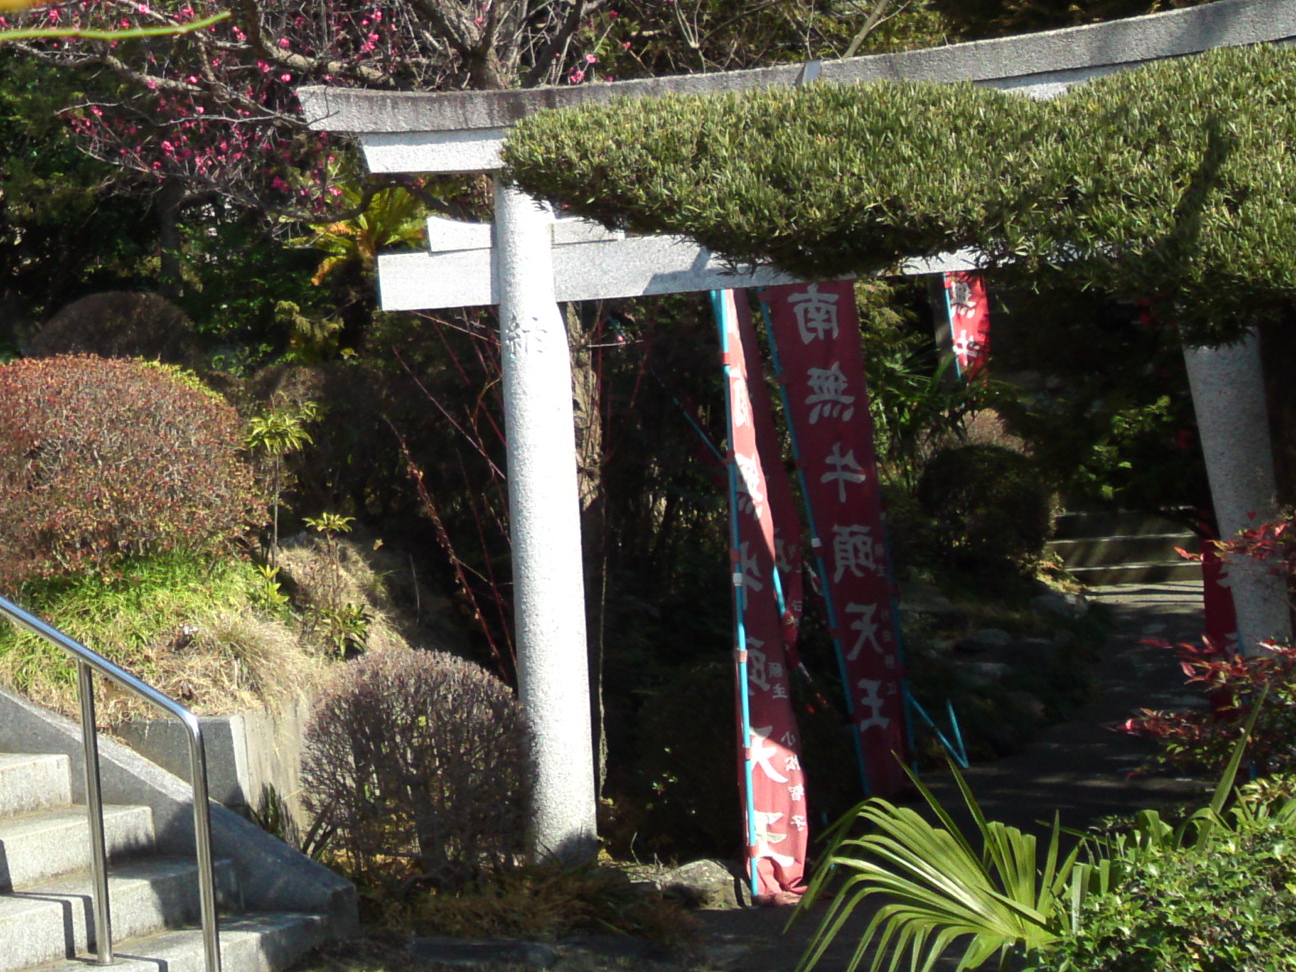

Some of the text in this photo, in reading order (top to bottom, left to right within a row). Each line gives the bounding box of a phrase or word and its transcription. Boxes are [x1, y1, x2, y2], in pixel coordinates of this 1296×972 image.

[787, 284, 890, 733] 南無牛頭天王
